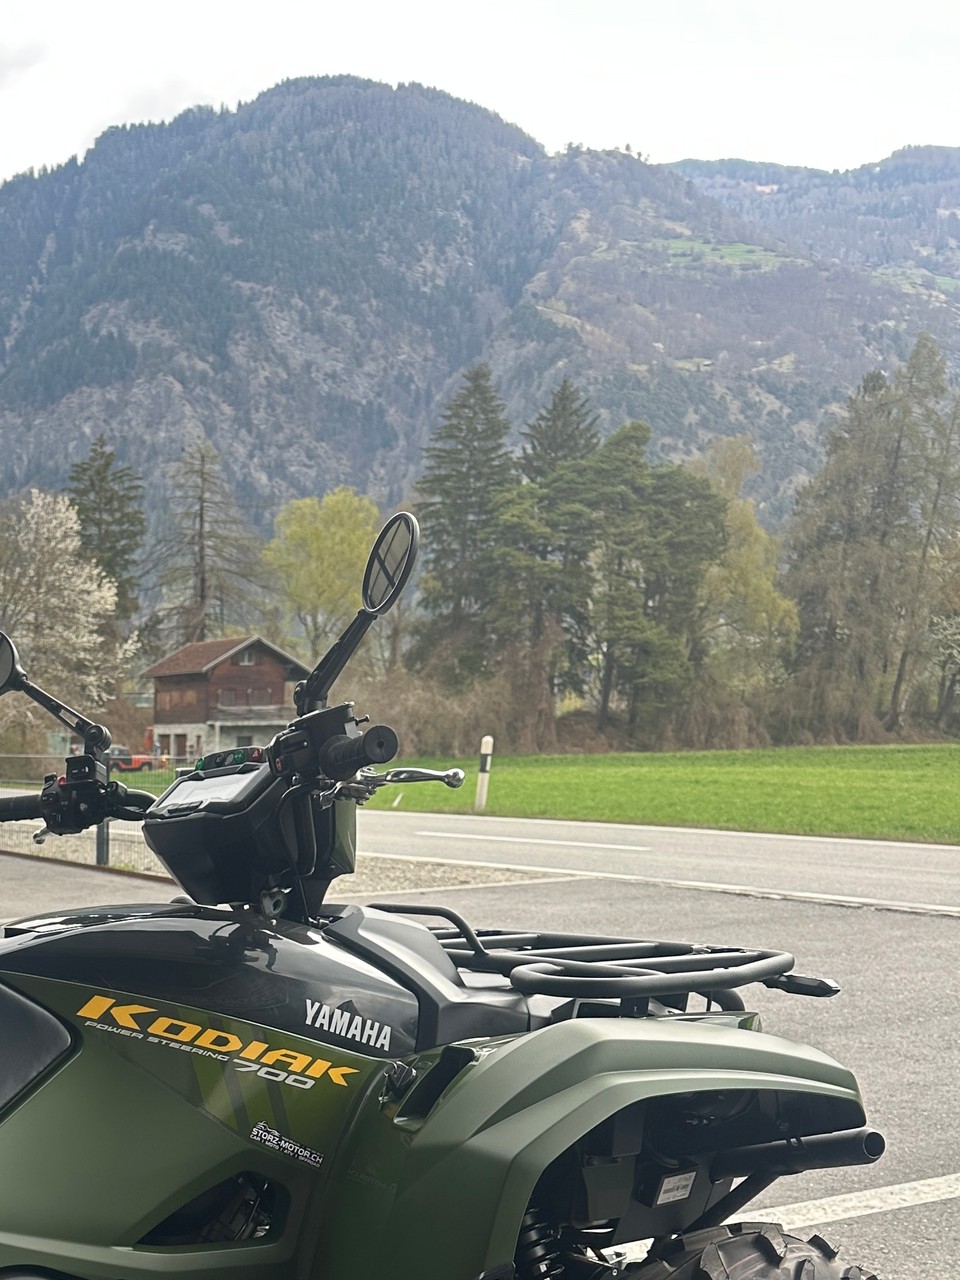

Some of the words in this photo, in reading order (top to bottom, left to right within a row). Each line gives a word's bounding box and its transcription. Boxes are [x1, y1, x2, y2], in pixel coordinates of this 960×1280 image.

[76, 995, 360, 1087] KODIAK
[84, 1020, 144, 1040] POWER
[146, 1036, 231, 1062] STEERING
[305, 998, 392, 1052] YAMAHA
[233, 1059, 317, 1091] 700
[251, 1127, 323, 1164] STORZ-MOTOR.CH
